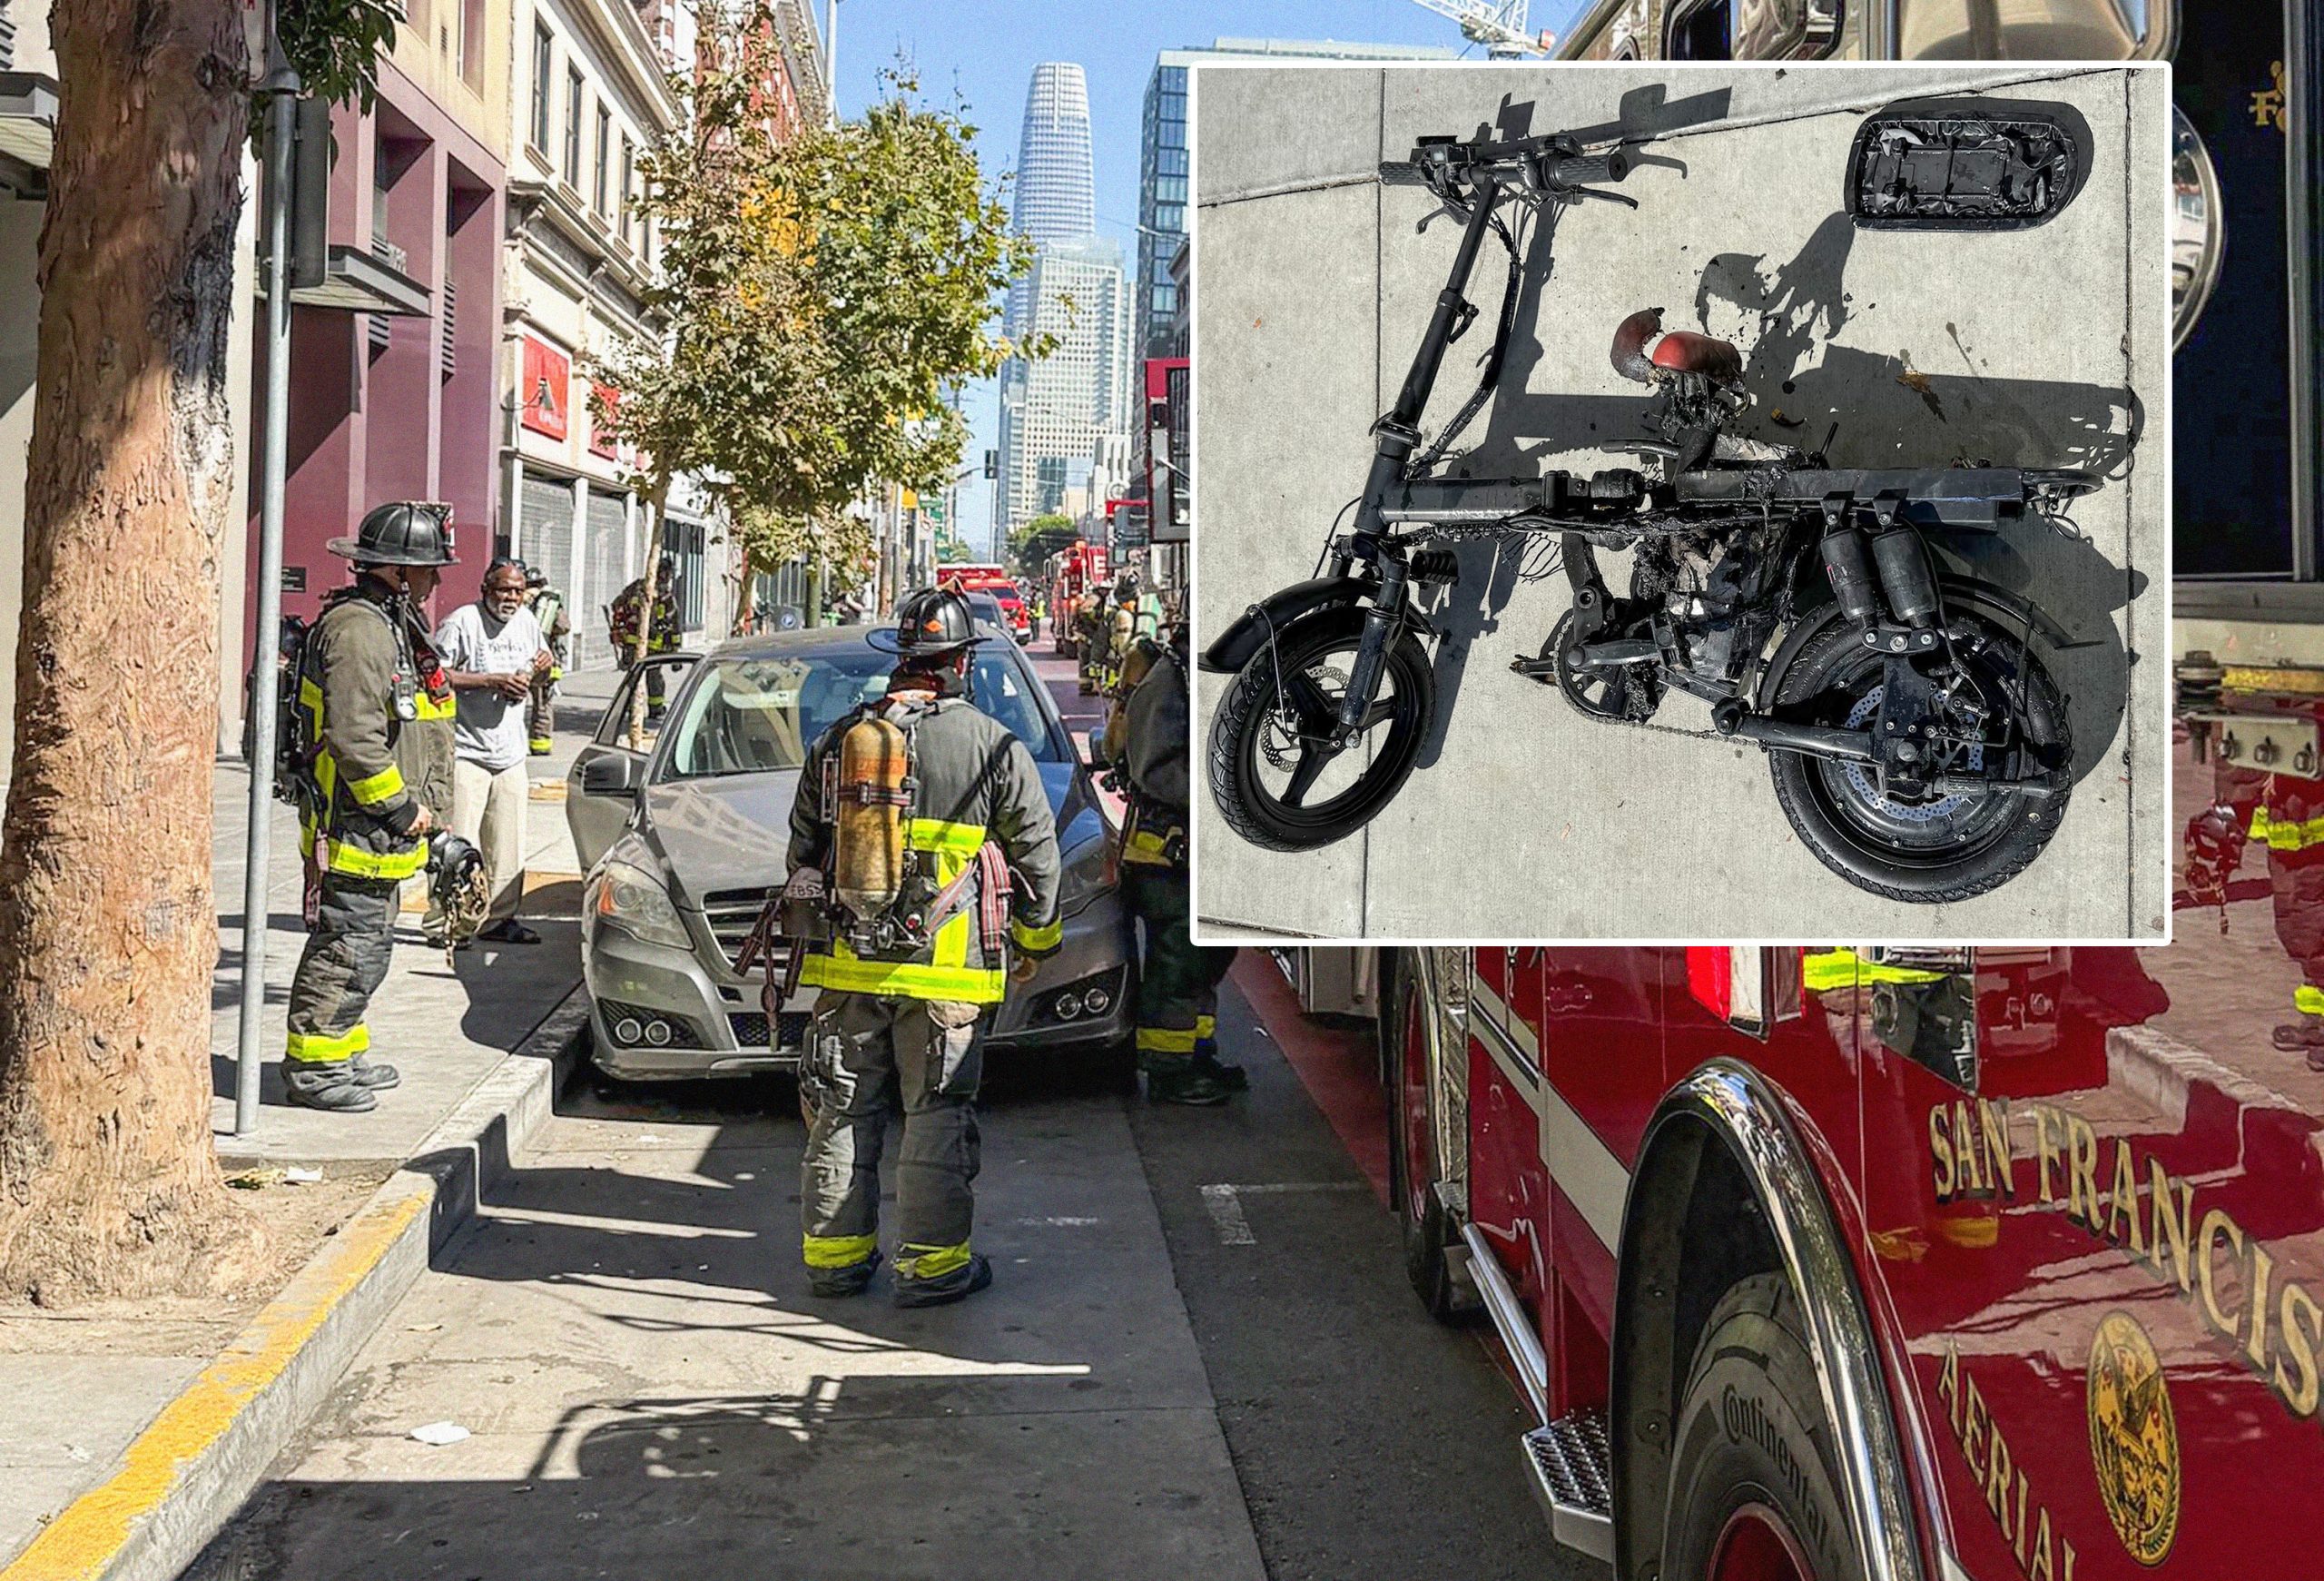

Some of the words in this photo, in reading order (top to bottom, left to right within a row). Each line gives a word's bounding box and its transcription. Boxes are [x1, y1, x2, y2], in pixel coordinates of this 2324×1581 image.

[1929, 1097, 2014, 1202] SAN
[2033, 1103, 2323, 1417] FRANCIS
[1722, 1383, 1828, 1552] Continental
